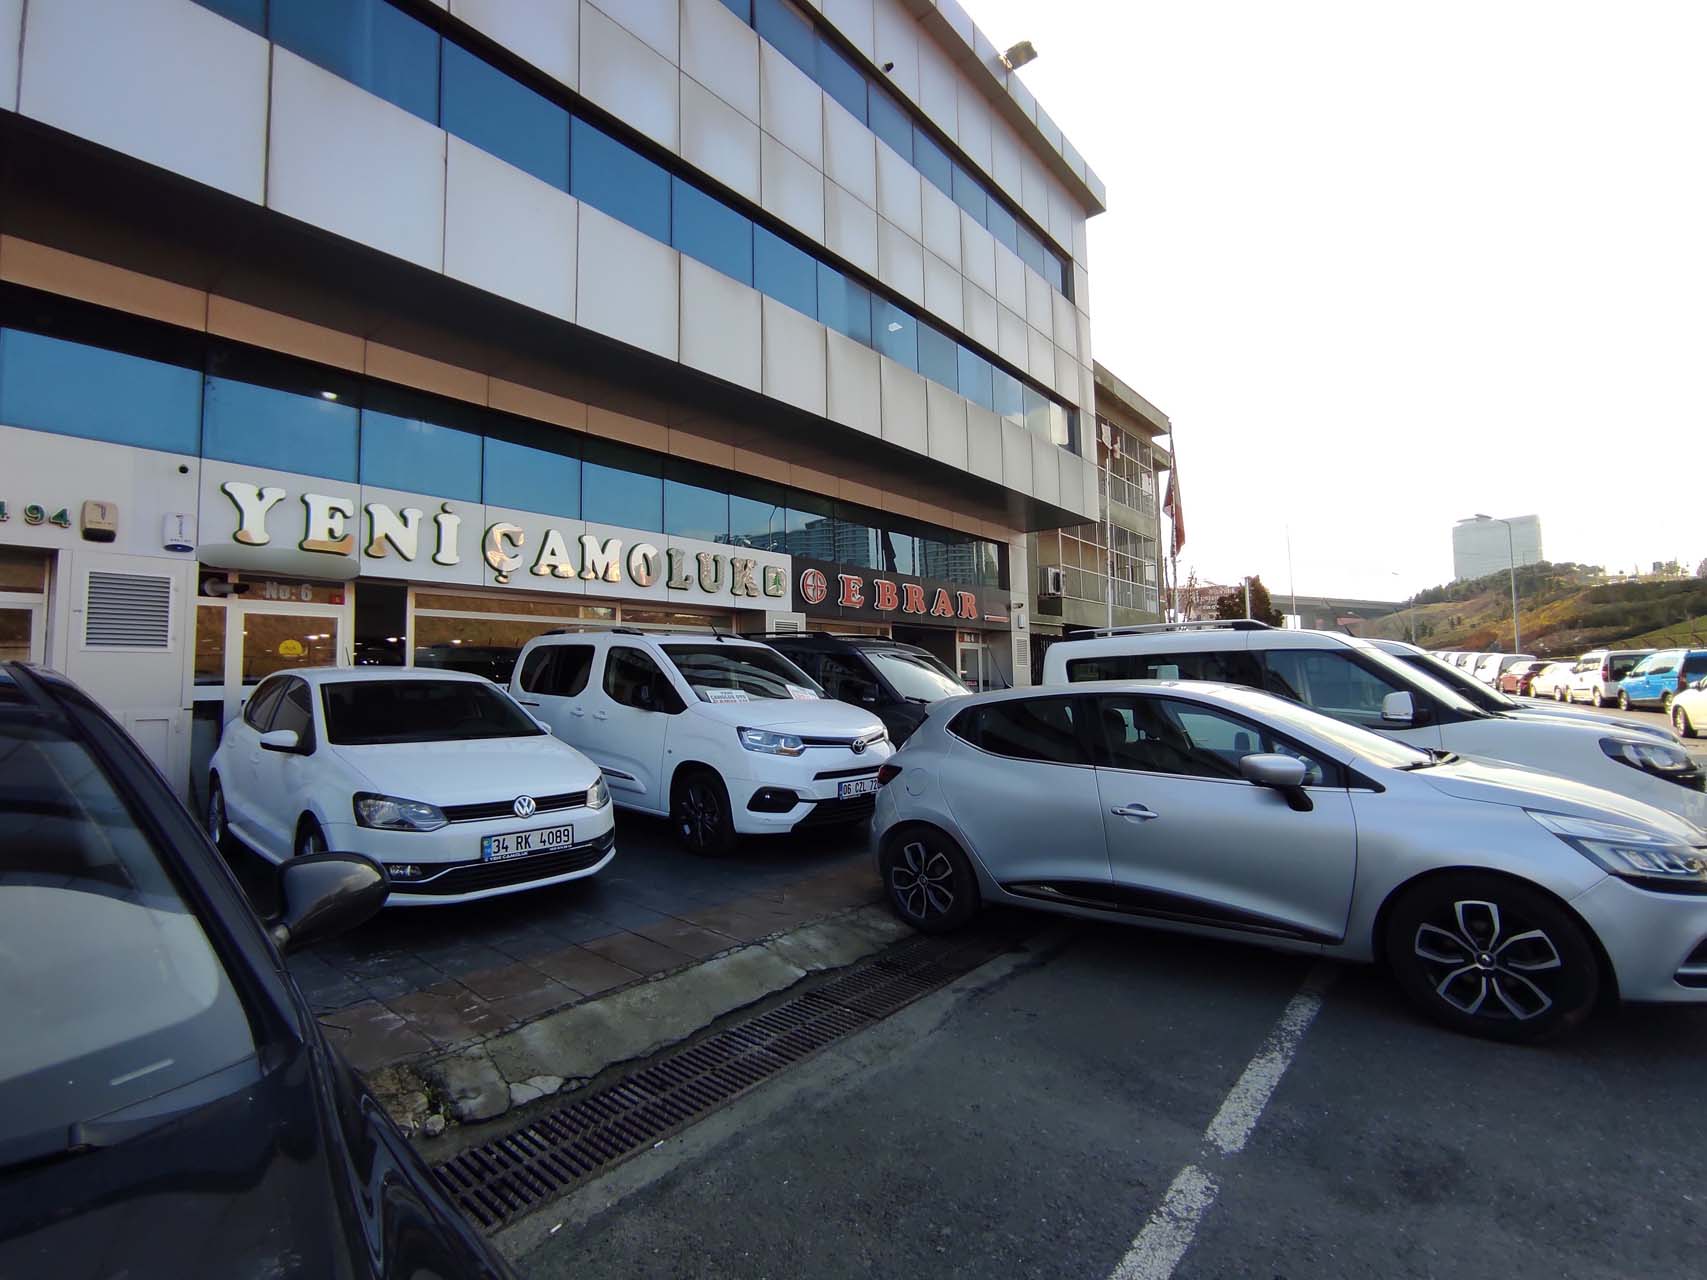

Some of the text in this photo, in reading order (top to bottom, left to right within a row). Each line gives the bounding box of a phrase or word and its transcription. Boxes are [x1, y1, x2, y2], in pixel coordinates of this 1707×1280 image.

[221, 481, 759, 597] YENİ ÇAMOLUK
[837, 573, 978, 620] EBRAR
[843, 783, 852, 795] 06
[492, 837, 509, 854] 34
[515, 833, 532, 851] RK
[539, 828, 570, 846] 4089
